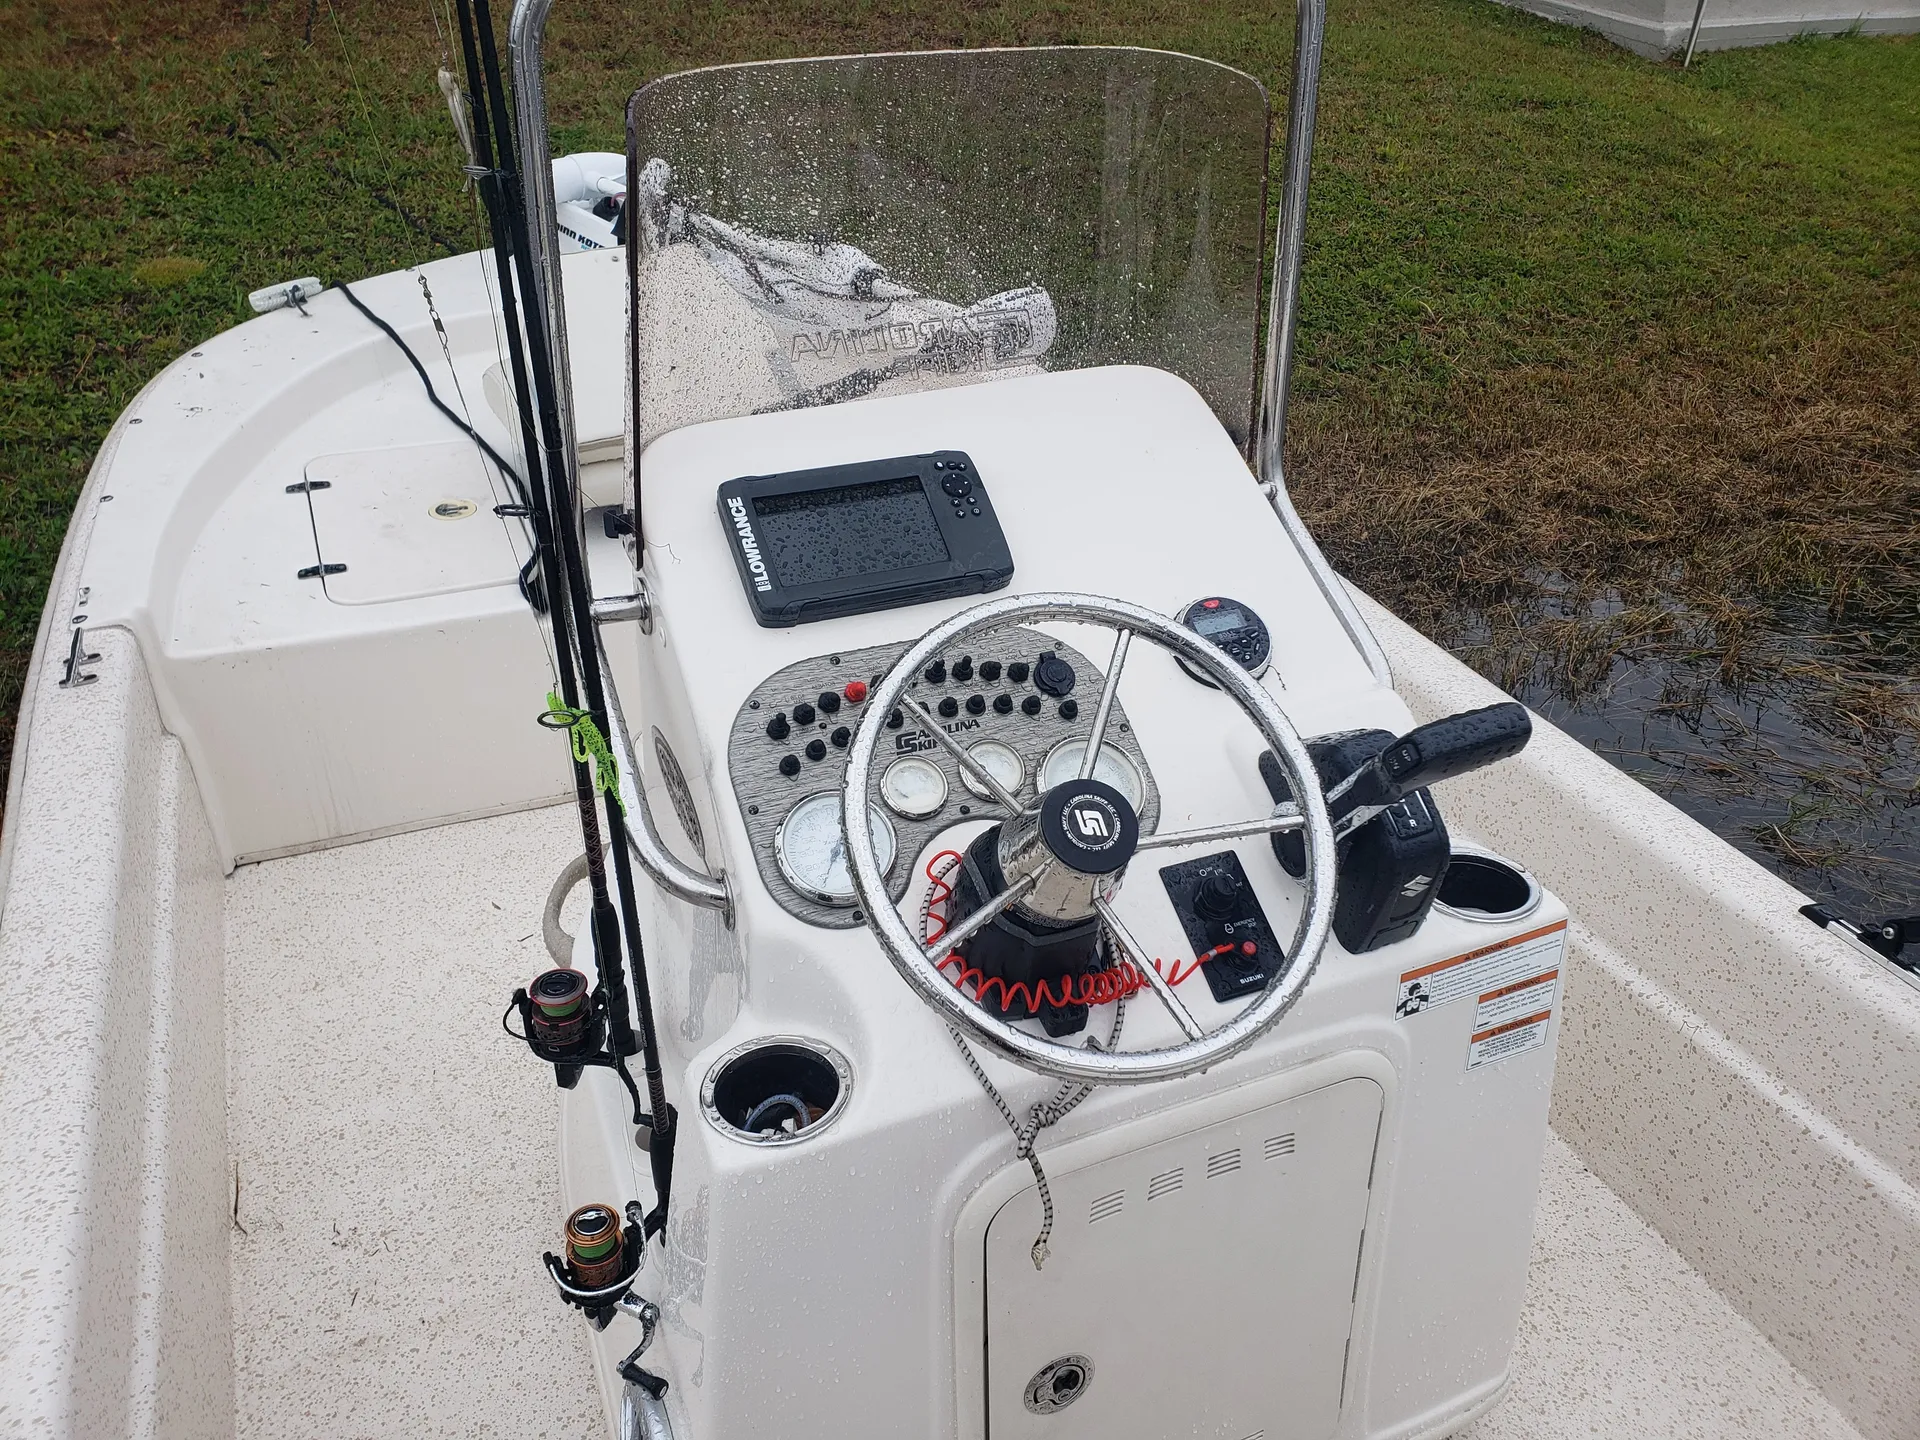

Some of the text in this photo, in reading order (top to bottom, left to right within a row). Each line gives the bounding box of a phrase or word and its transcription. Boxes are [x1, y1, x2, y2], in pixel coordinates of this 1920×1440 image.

[727, 497, 769, 582] LOWRANCE
[1402, 749, 1412, 762] UP
[1473, 941, 1510, 958] WARNING
[1239, 973, 1265, 984] SUZUKI
[1505, 977, 1541, 993] WARNING
[1498, 1017, 1533, 1034] WARNING
